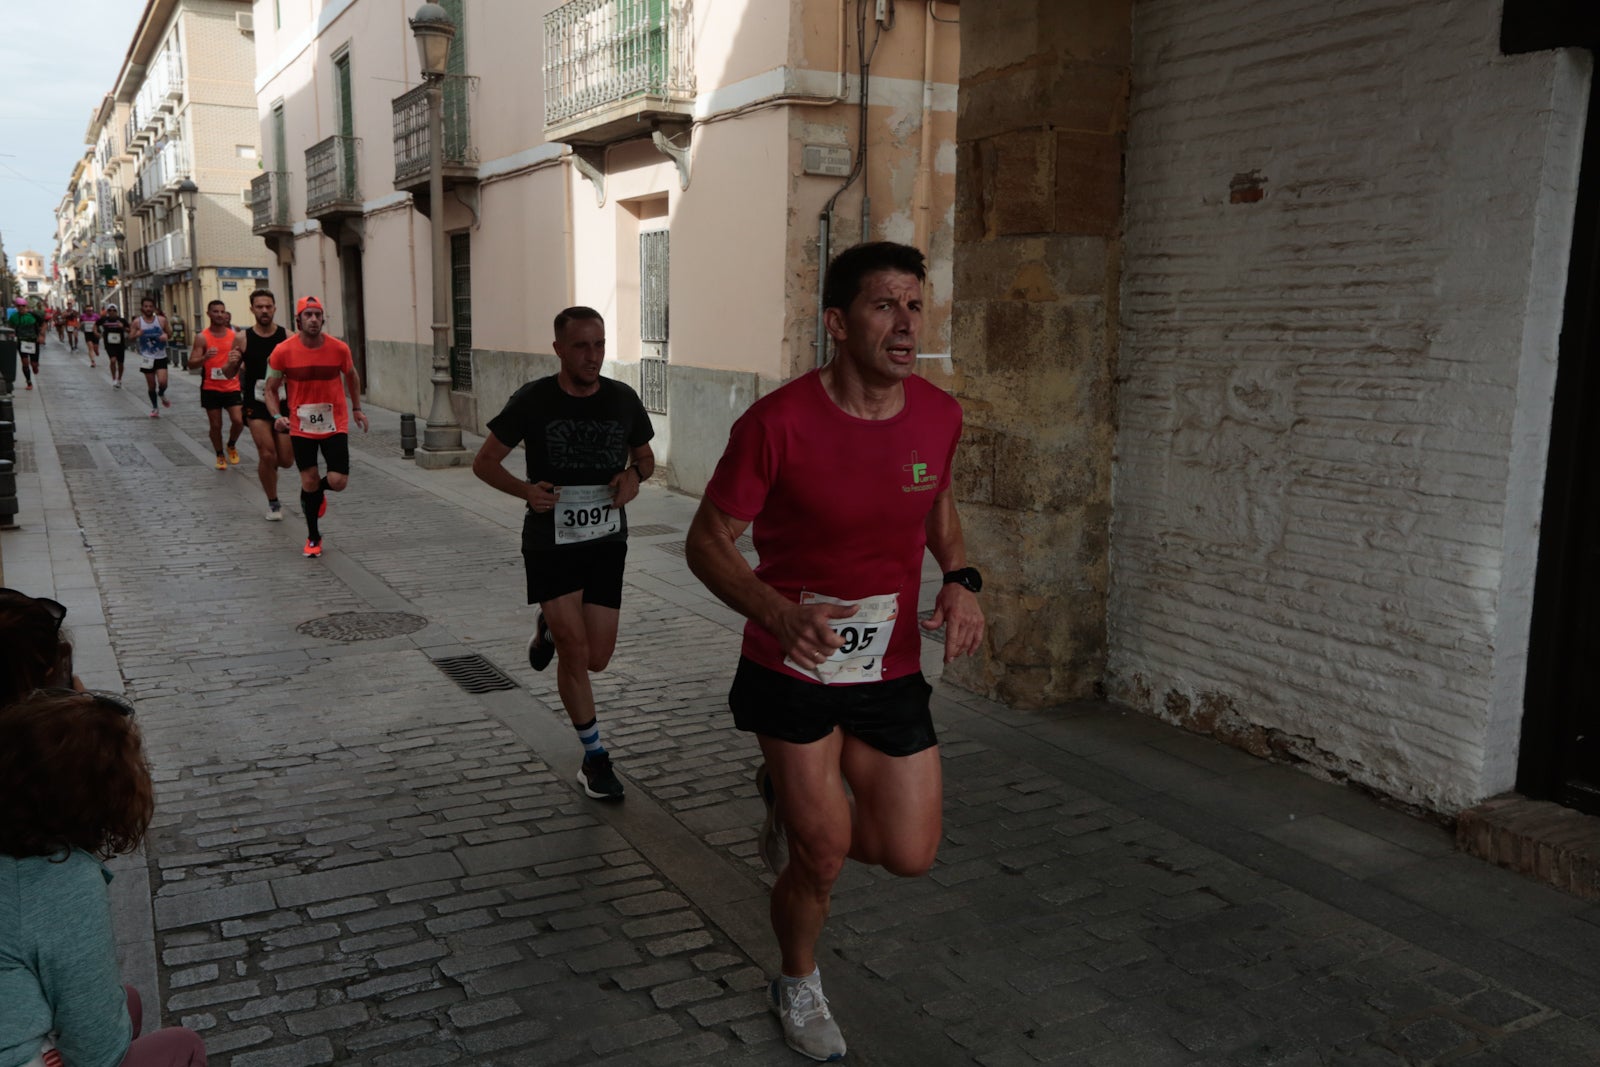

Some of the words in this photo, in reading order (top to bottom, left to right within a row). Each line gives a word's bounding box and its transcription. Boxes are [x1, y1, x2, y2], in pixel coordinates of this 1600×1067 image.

[310, 414, 324, 424] 84
[563, 504, 611, 527] 3097
[833, 627, 878, 654] 95
